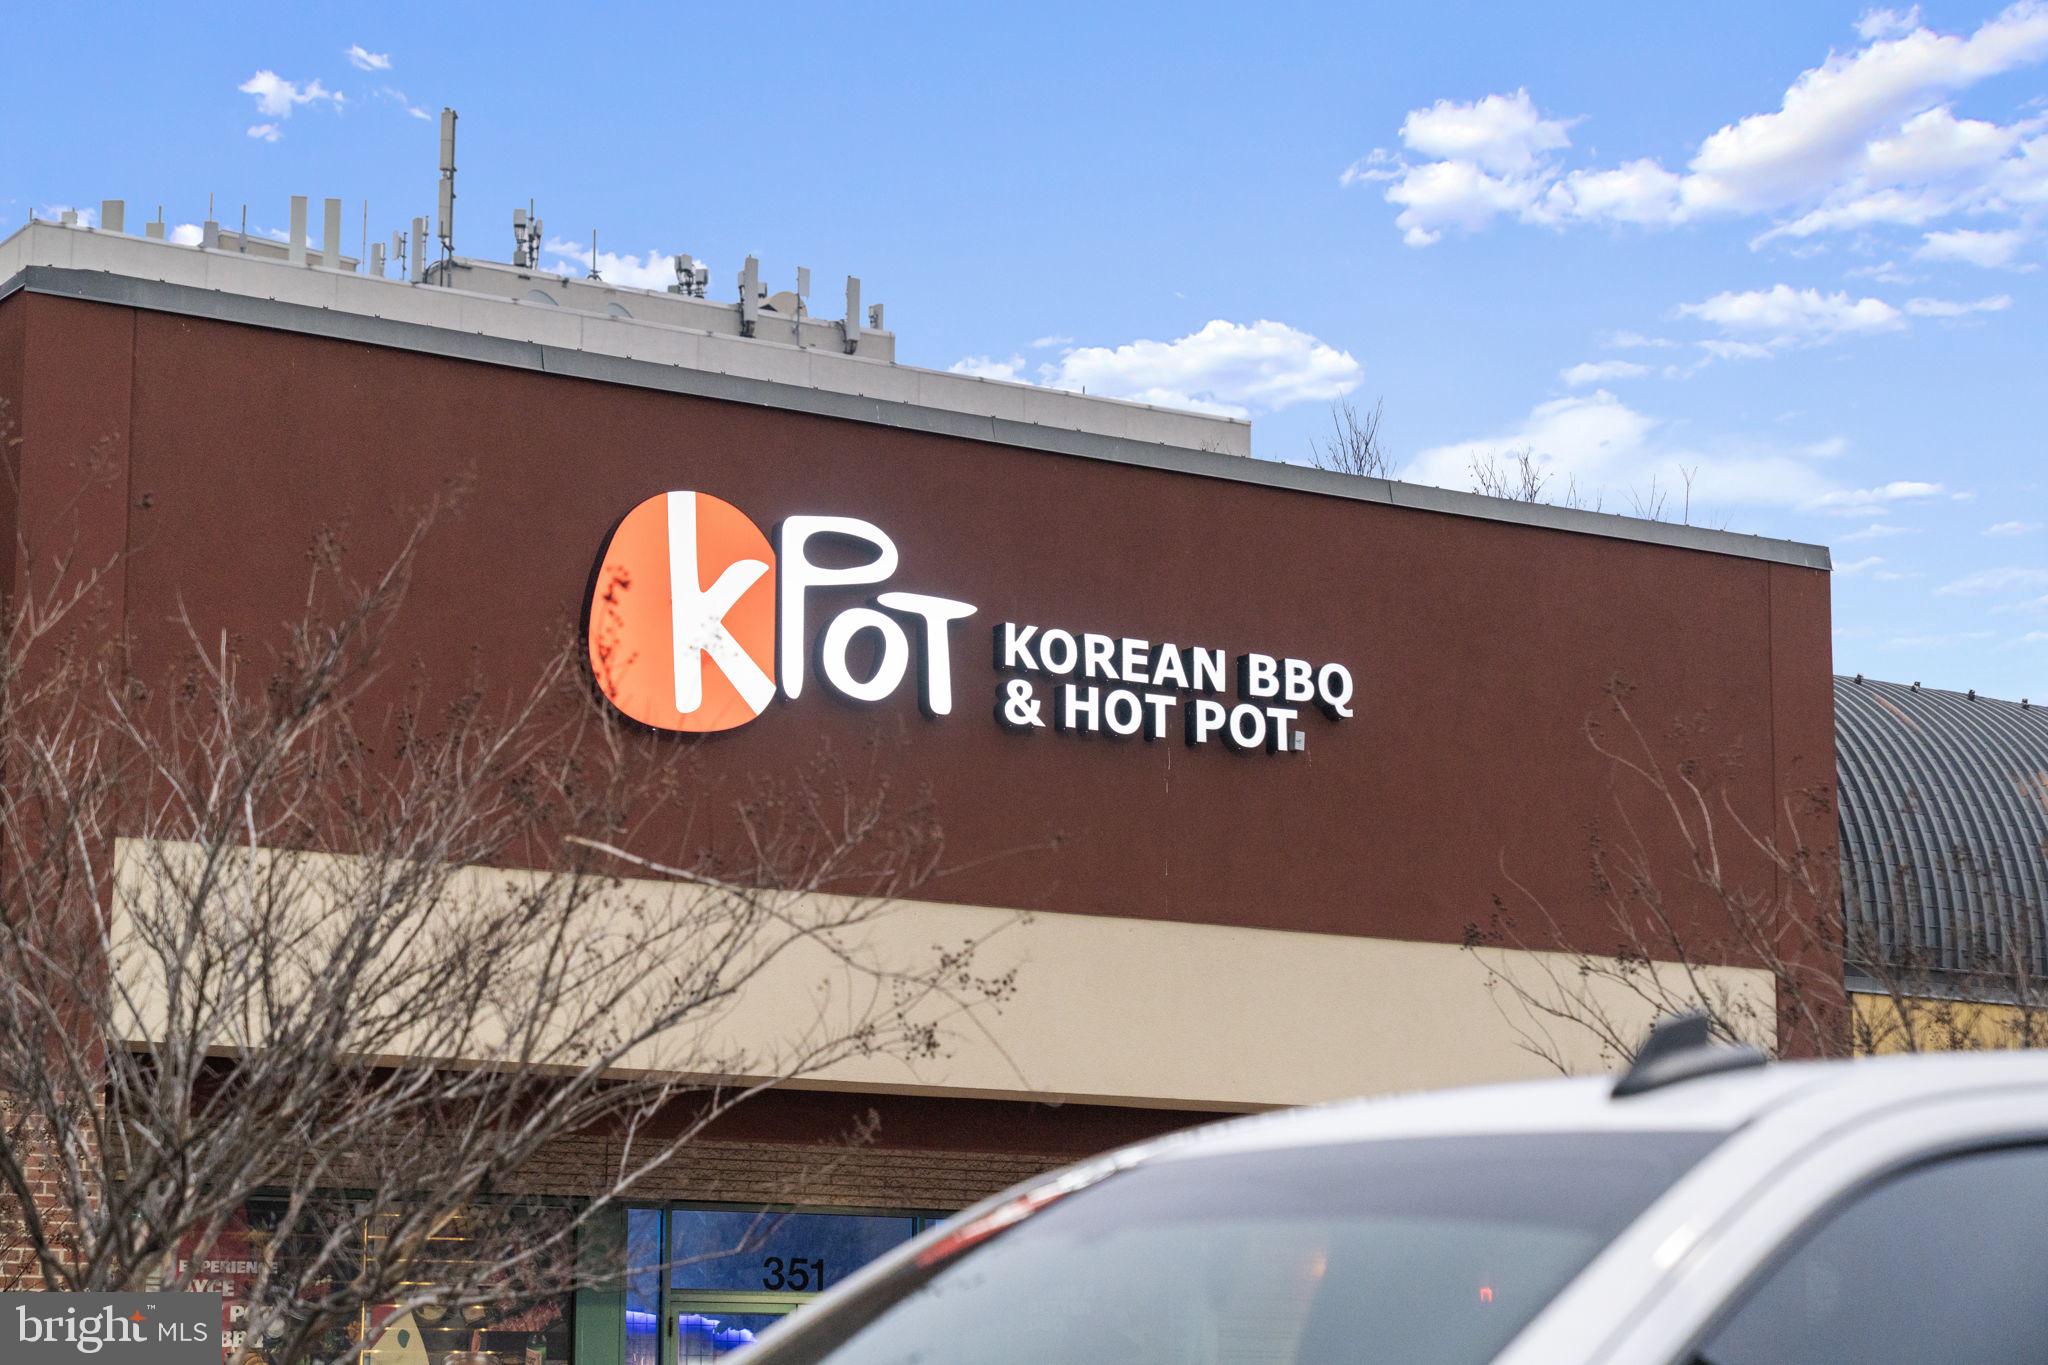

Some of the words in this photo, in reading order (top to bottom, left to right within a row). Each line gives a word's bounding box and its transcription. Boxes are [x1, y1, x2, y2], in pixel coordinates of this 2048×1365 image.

[1004, 622, 1226, 692] KOREAN
[1249, 653, 1354, 718] BBQ
[1004, 679, 1046, 727] &
[1065, 684, 1177, 738] HOT
[178, 1260, 279, 1274] EPERIENE
[762, 1256, 825, 1291] 351
